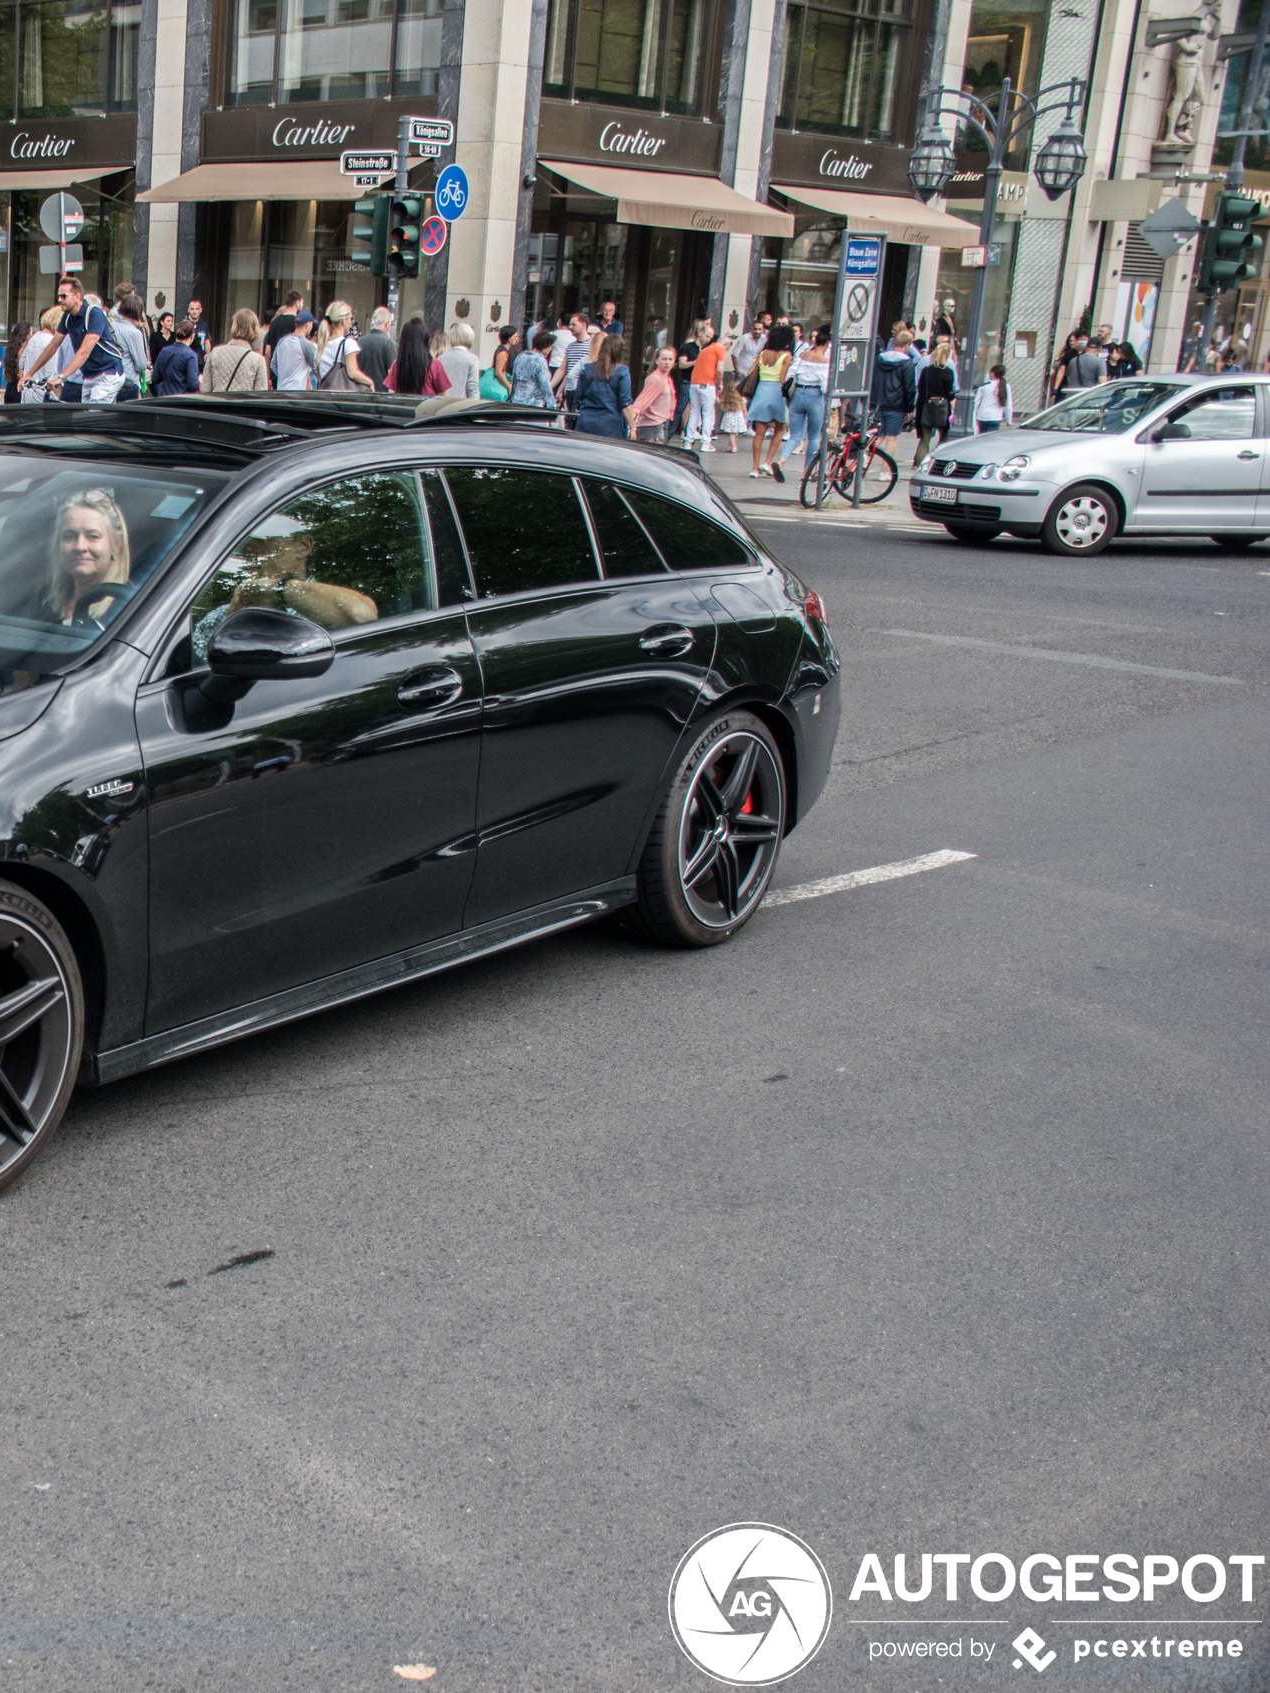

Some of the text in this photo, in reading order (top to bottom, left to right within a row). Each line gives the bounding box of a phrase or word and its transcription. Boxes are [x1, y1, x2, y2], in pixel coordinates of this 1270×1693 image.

[272, 117, 355, 147] Cartier
[416, 125, 448, 138] Königsallee
[599, 121, 666, 156] Cartier
[10, 132, 75, 159] Cartier
[348, 157, 388, 169] Steinstraße
[819, 149, 873, 179] Cartier
[691, 210, 725, 229] Cartier
[903, 226, 930, 243] Cartier
[849, 247, 877, 257] Blaue Zone
[847, 259, 877, 270] Königsallee
[846, 326, 863, 335] ZONE
